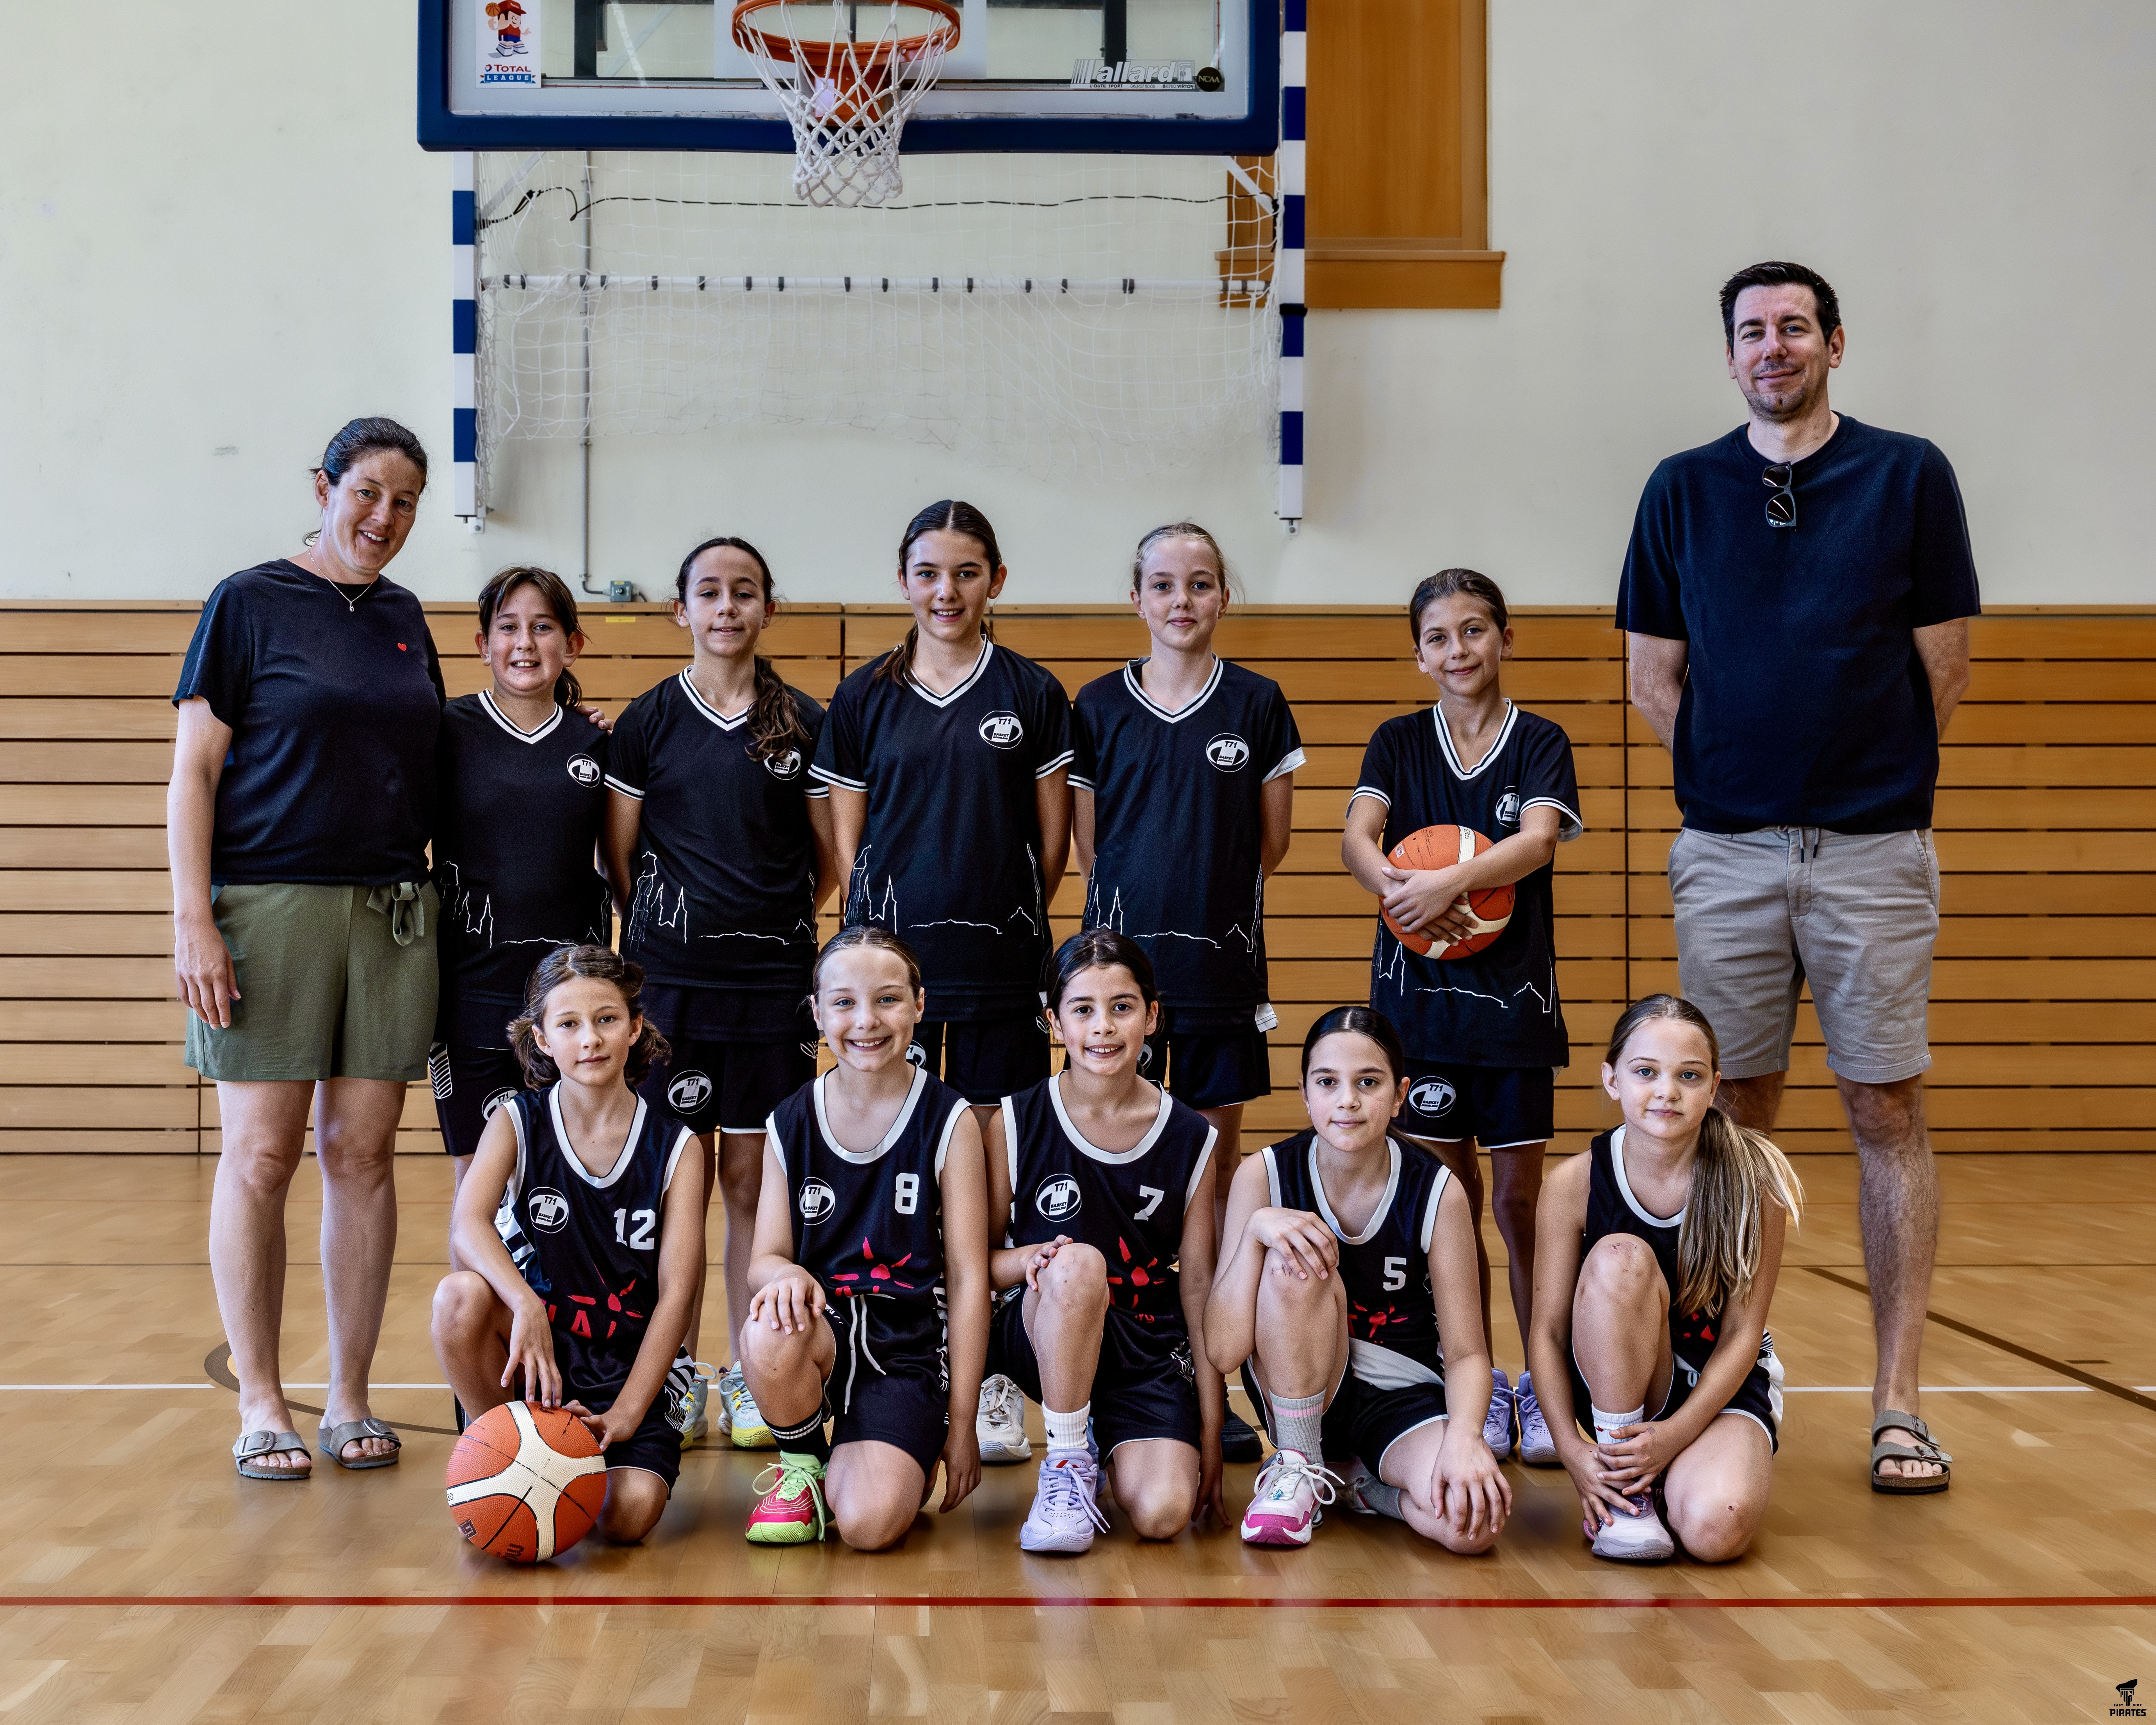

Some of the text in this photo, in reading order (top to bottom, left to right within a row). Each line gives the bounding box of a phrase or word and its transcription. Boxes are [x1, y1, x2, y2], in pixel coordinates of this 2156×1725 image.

[687, 1077, 700, 1086] T71
[497, 1092, 509, 1103] T71
[808, 1187, 821, 1195] T71
[1054, 1181, 1068, 1192] T71
[895, 1173, 919, 1215] 8
[544, 1196, 557, 1205] T71
[1134, 1185, 1164, 1221] 7
[614, 1208, 656, 1249] 12
[1383, 1257, 1406, 1291] 5
